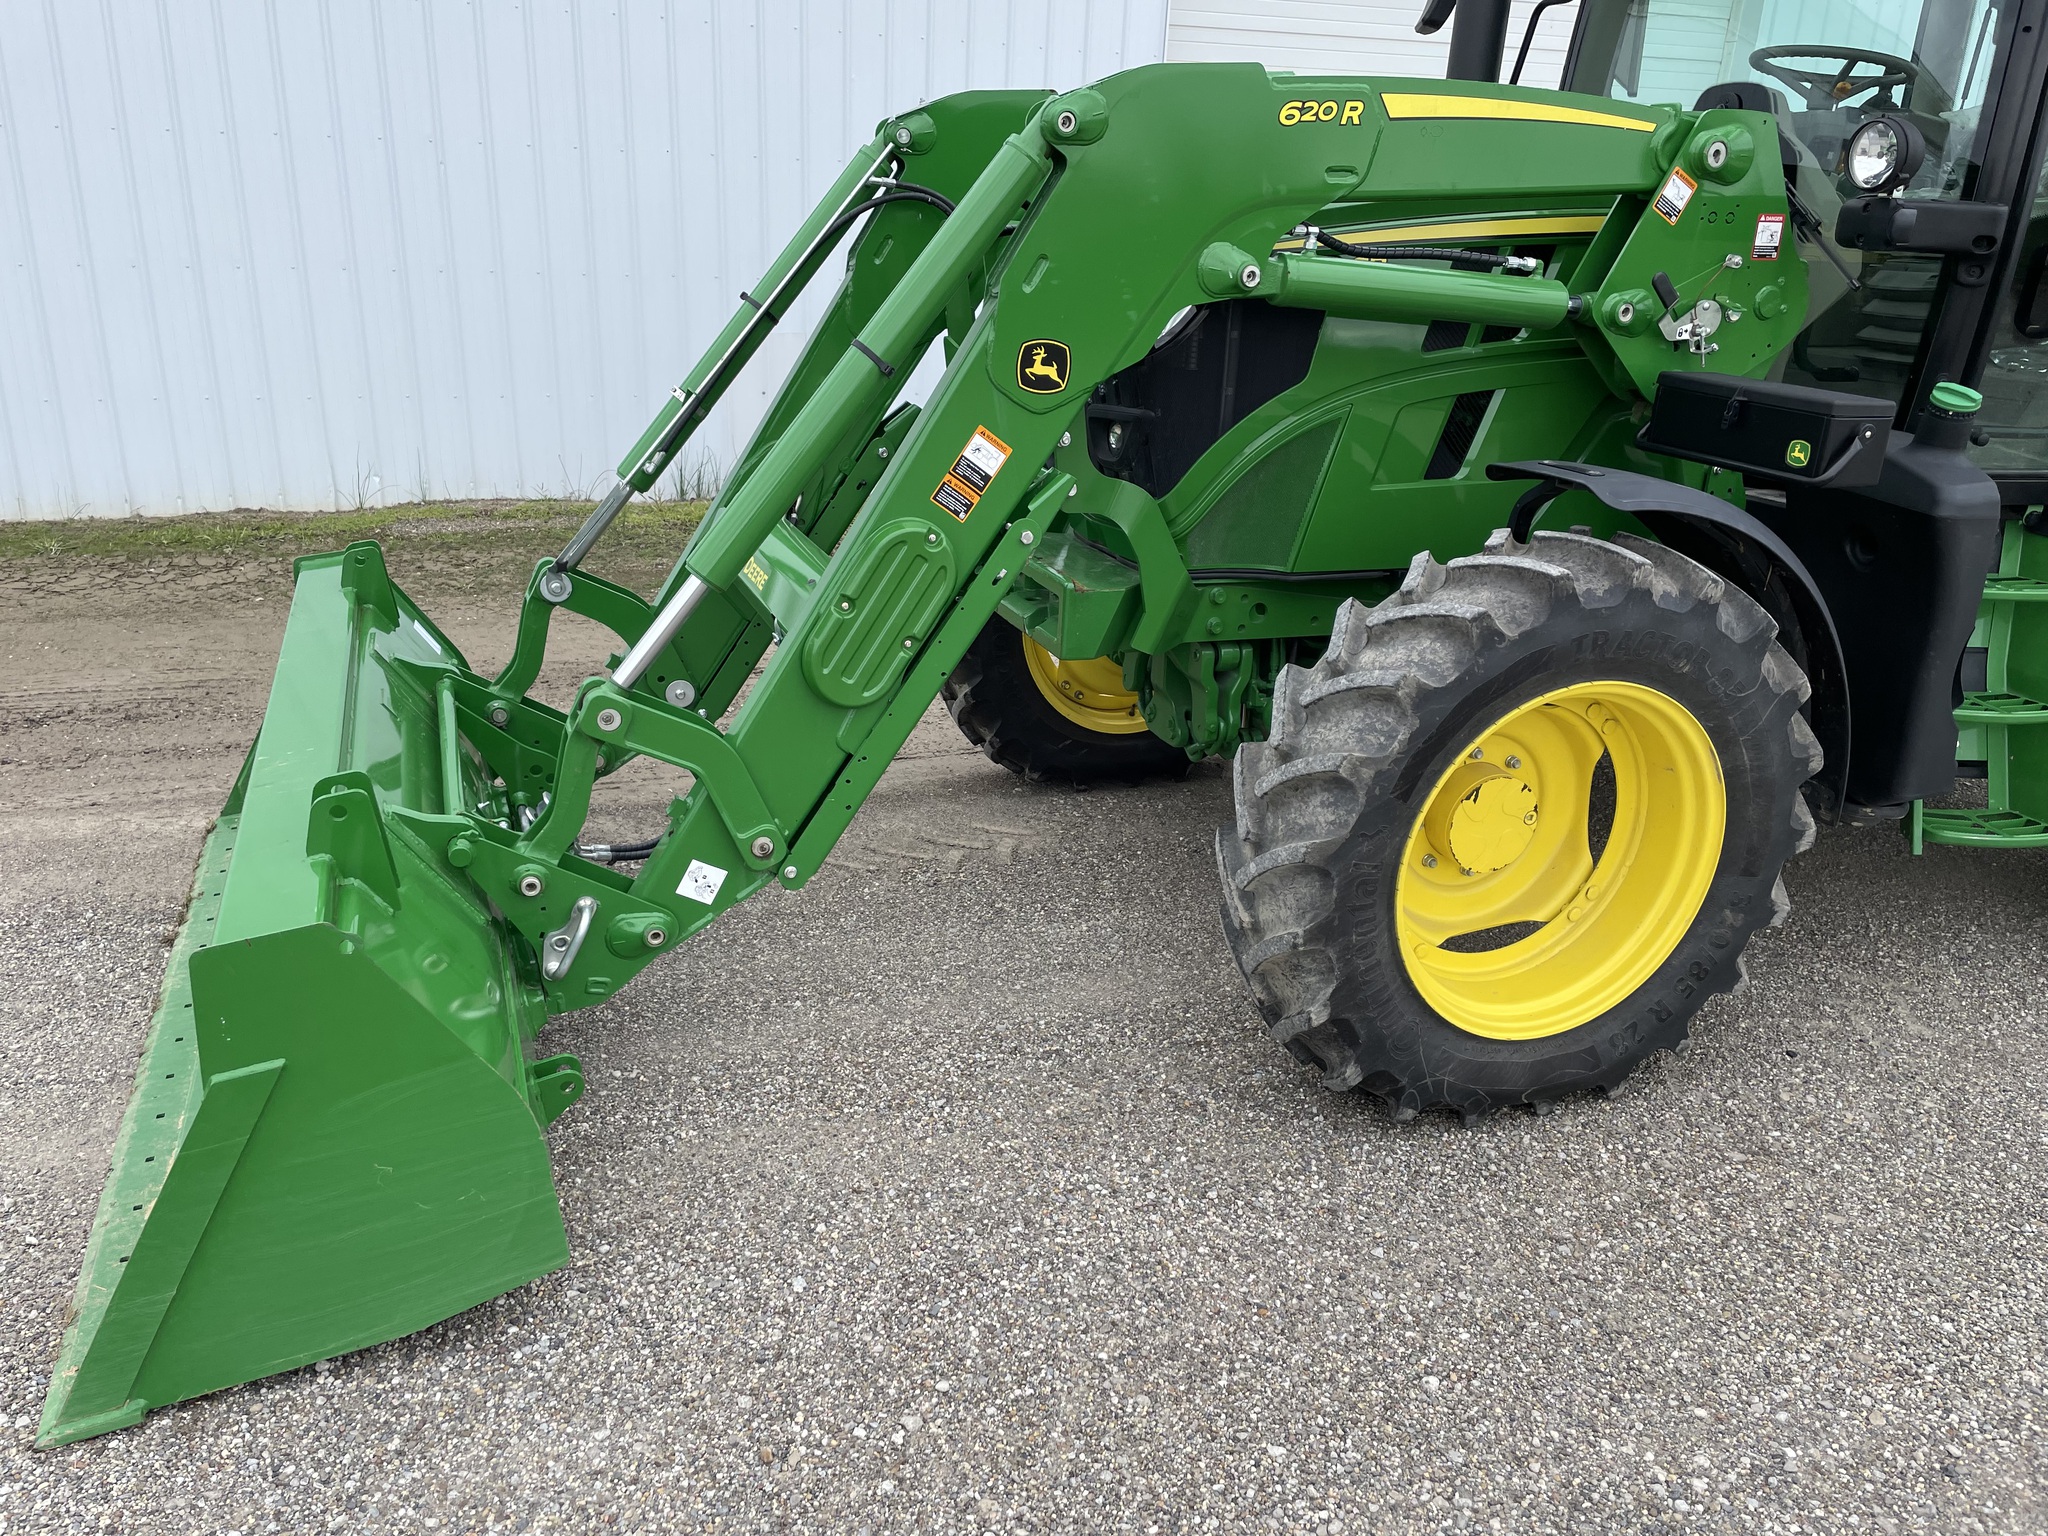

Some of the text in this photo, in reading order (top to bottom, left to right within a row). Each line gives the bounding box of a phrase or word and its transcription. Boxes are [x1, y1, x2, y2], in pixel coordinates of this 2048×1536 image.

[1679, 173, 1695, 189] WARNING
[985, 434, 1008, 453] WARNING
[953, 482, 975, 501] WARNING
[743, 556, 769, 591] DEERE
[1570, 629, 1712, 677] TRACTOR
[1607, 891, 1753, 1058] 30/85 R 28
